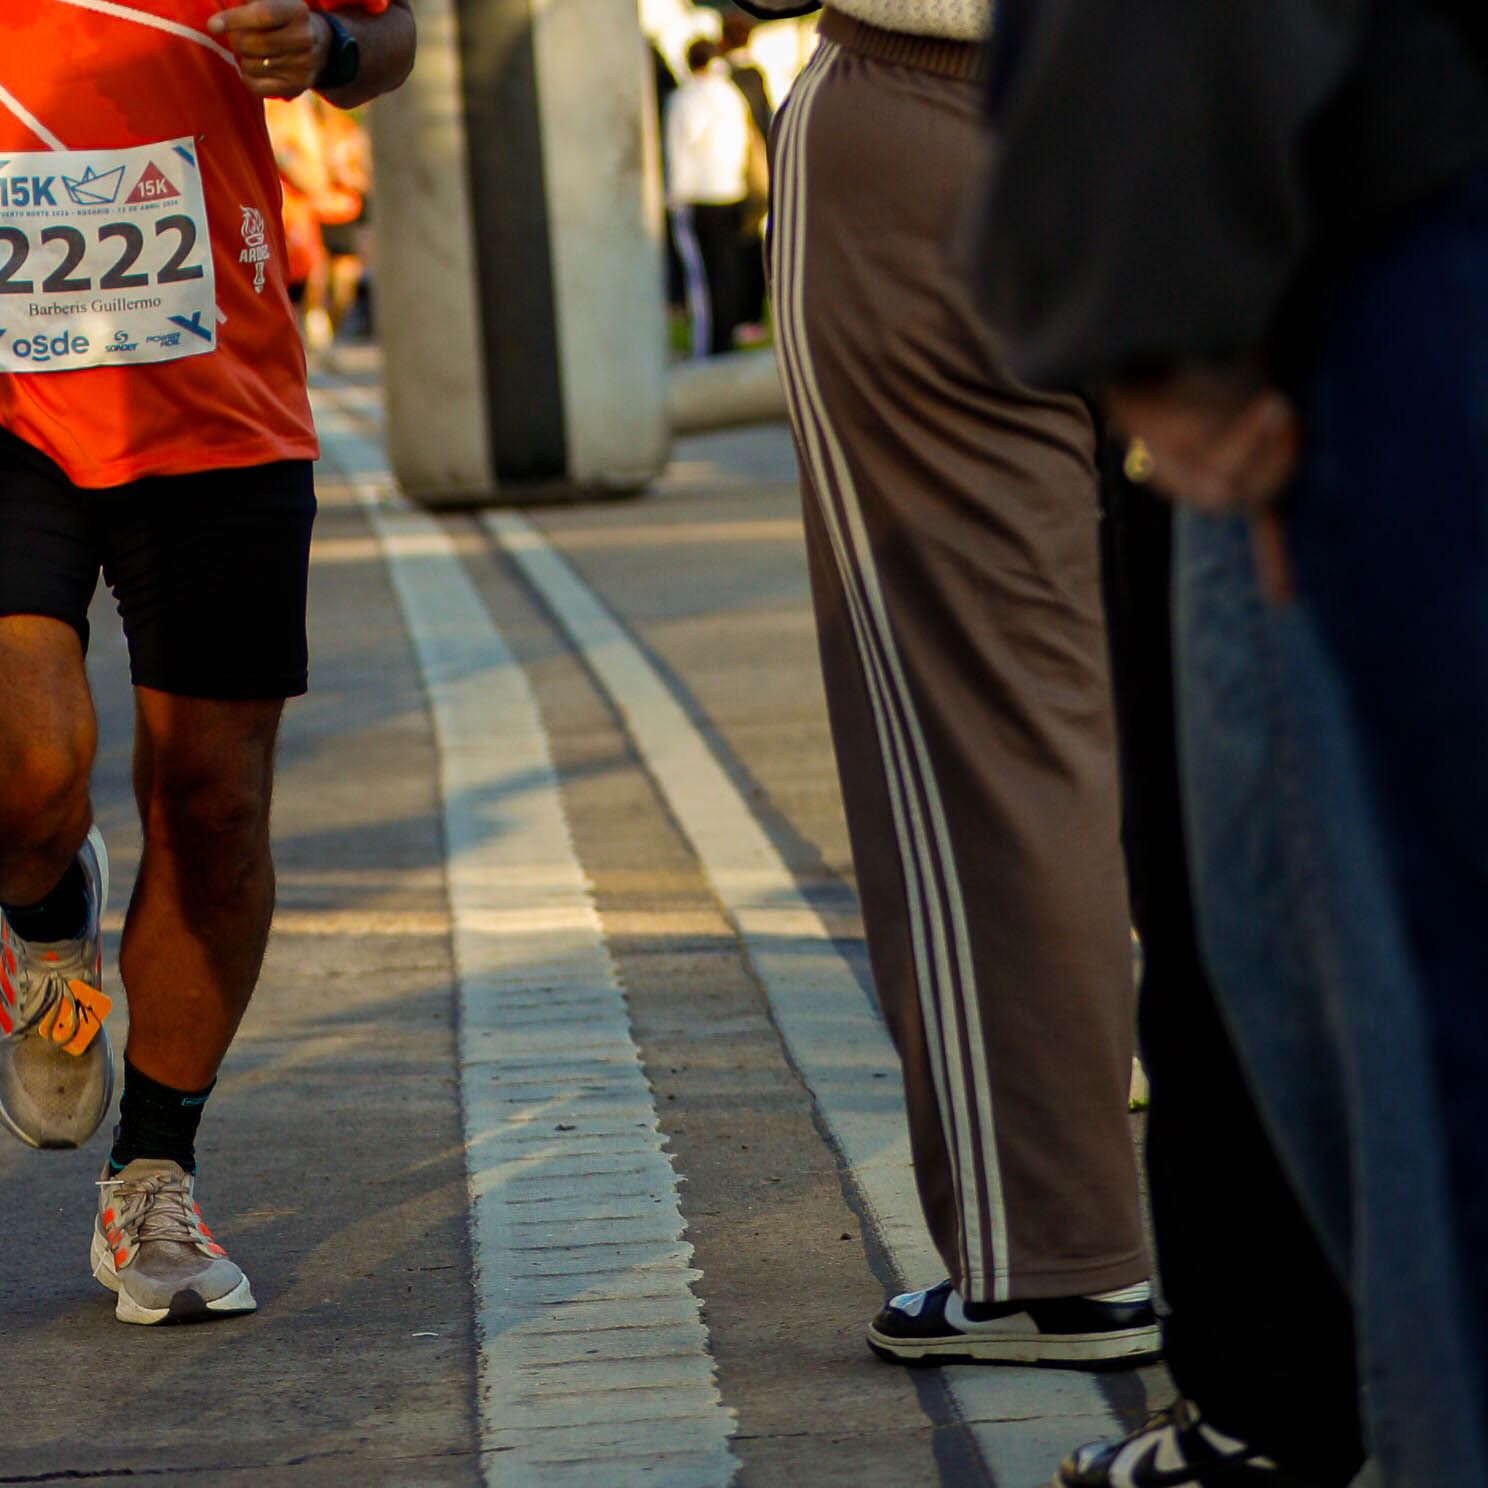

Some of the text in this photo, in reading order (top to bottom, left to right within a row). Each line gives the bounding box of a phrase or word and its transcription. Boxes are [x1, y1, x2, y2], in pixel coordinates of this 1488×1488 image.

[137, 179, 168, 197] 15K
[28, 297, 162, 316] Barberis Guillermo
[12, 329, 90, 360] osde
